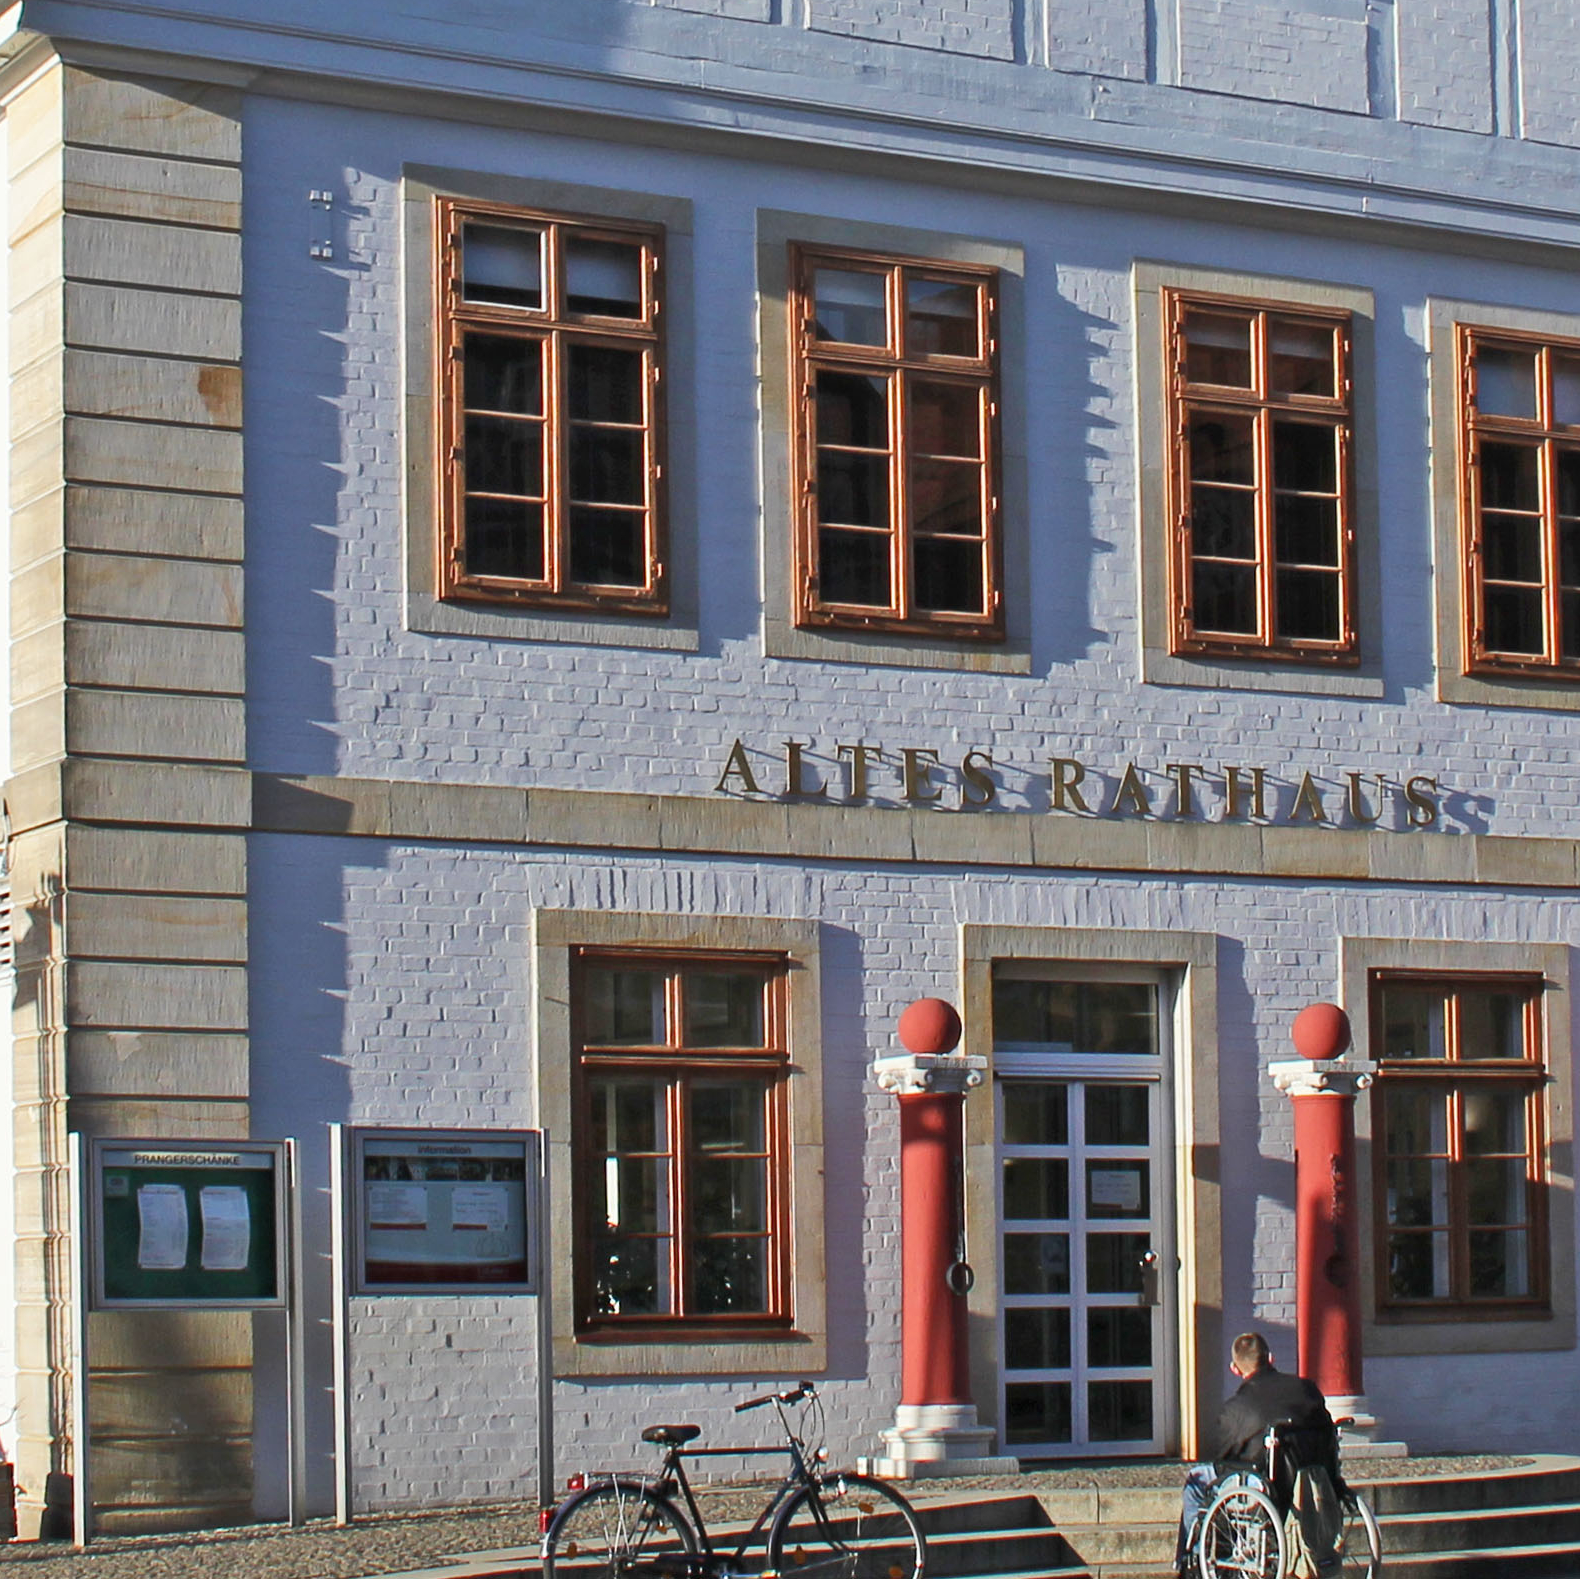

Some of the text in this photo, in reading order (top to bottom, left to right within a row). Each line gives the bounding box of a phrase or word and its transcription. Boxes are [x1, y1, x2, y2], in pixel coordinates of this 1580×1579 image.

[714, 738, 1438, 826] ALTES RATHAUS
[133, 1153, 240, 1166] PRANGERSCHÄNKE
